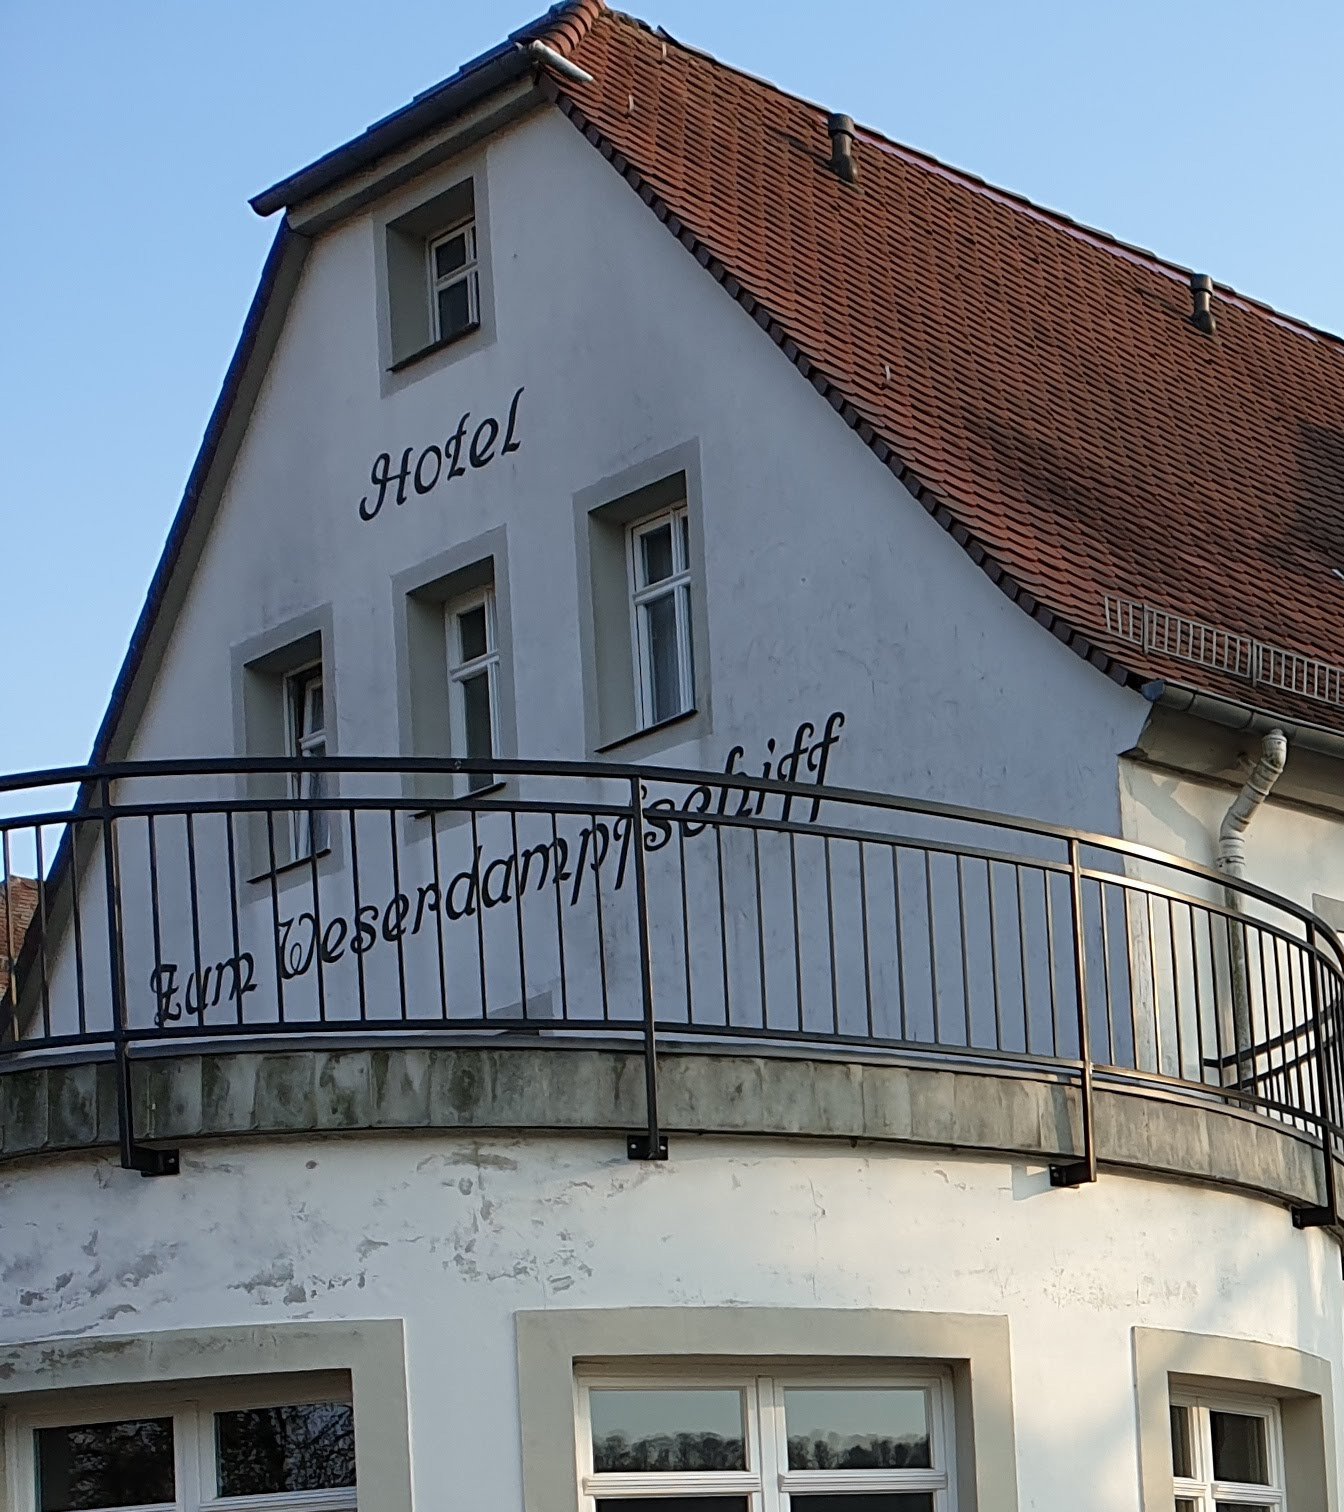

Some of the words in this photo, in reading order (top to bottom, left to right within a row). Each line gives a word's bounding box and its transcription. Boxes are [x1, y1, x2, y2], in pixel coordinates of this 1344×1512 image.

[359, 387, 525, 522] Hotel
[150, 951, 257, 1027] Zum
[278, 711, 846, 980] Weserdampfschiff
